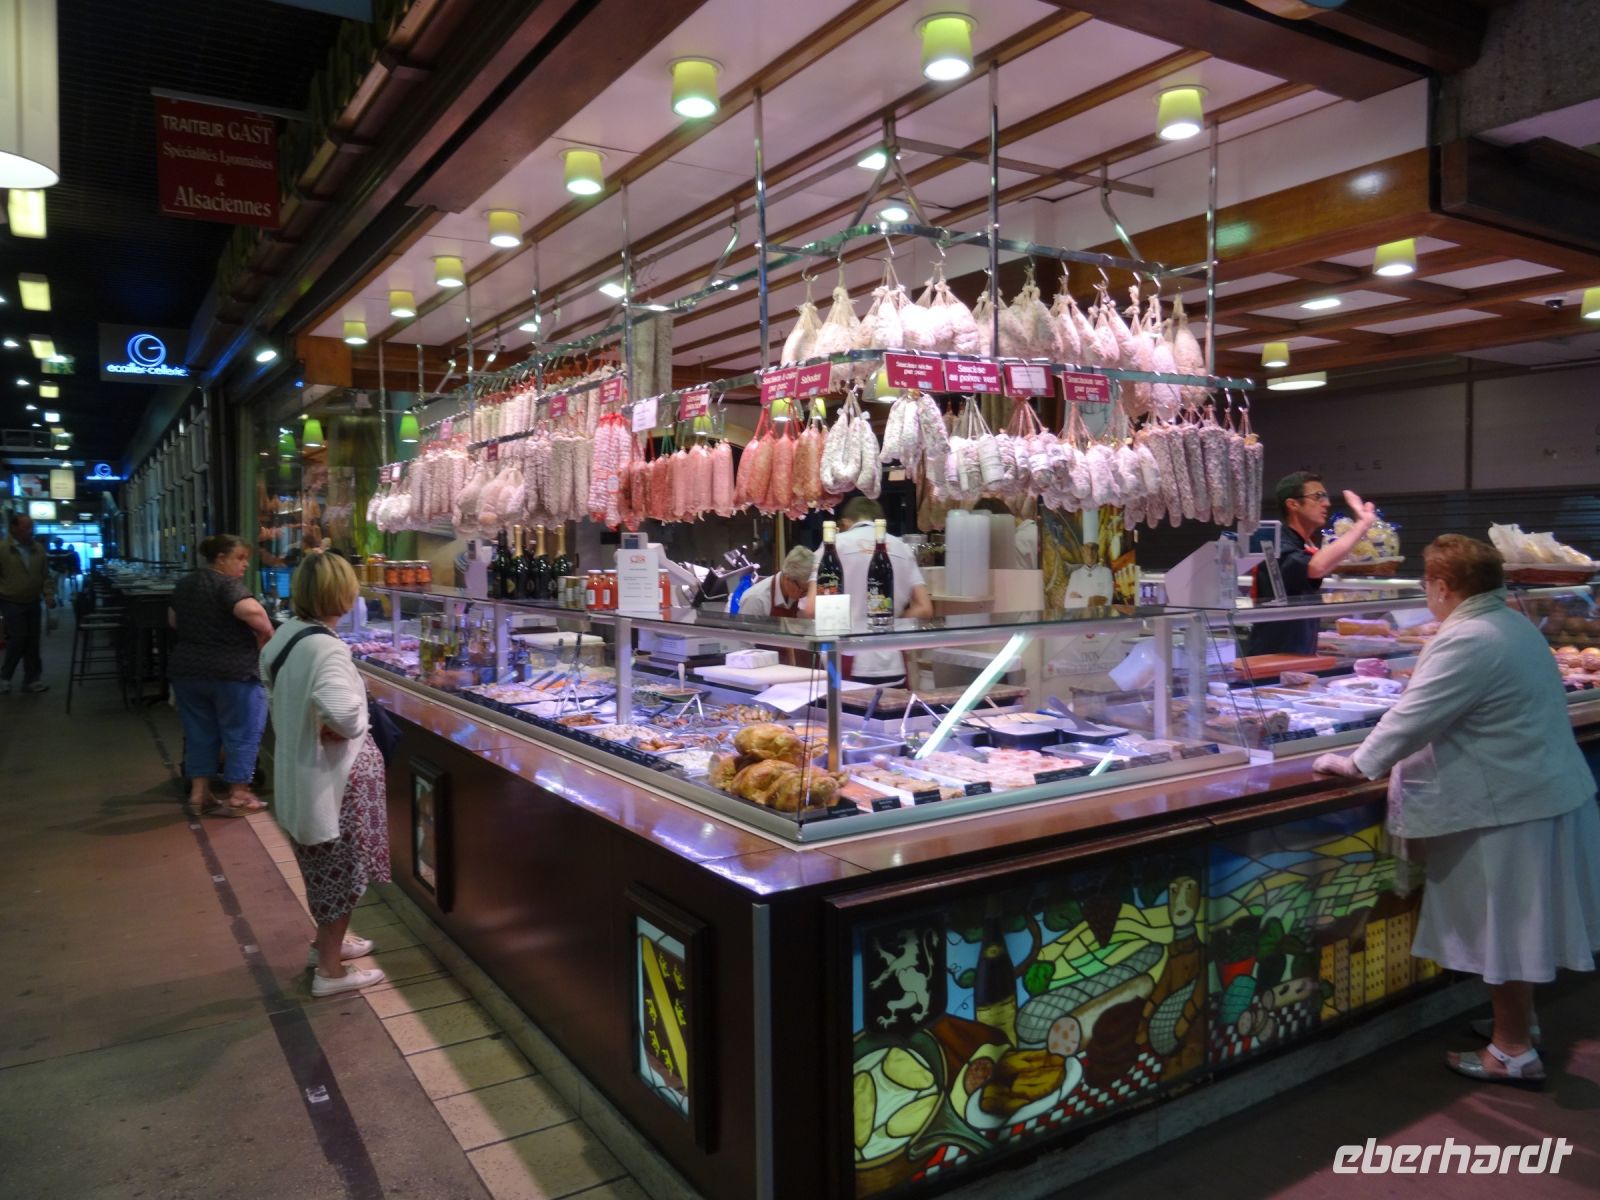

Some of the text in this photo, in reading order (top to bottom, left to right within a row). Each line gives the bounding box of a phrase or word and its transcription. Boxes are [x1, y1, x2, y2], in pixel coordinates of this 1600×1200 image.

[160, 114, 273, 145] TRAITEUR GAST
[219, 149, 274, 170] Lyonnaises
[214, 173, 225, 187] &
[173, 185, 272, 217] Alsaciennes
